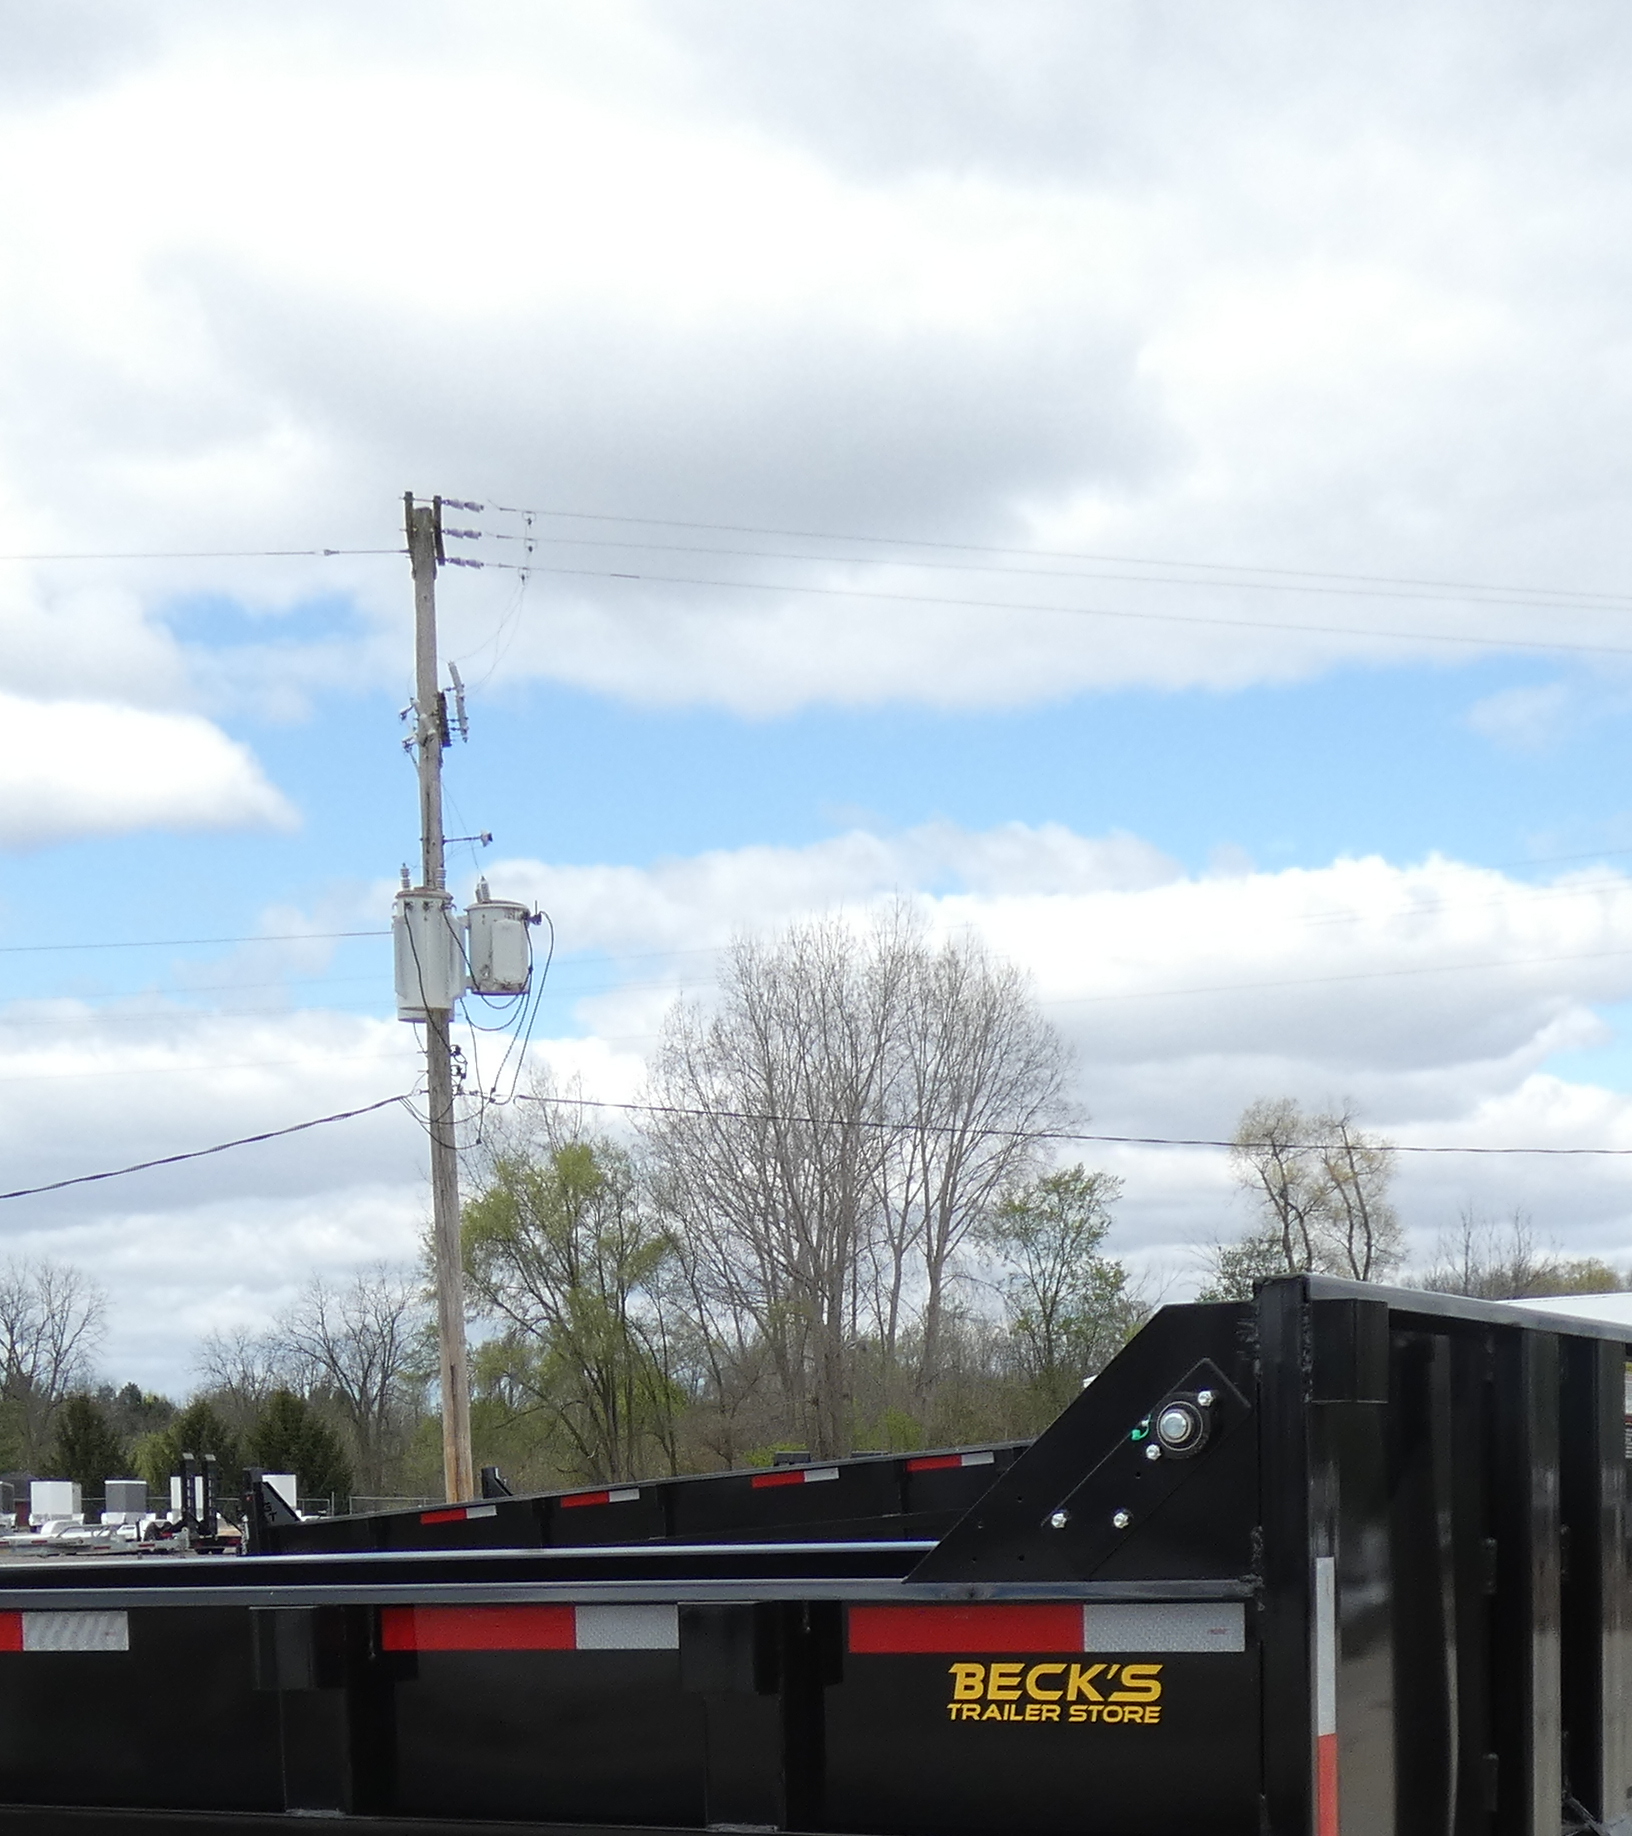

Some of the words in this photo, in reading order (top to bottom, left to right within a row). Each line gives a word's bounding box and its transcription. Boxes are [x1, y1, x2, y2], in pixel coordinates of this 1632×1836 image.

[948, 1663, 1164, 1702] BECK'S
[947, 1703, 1061, 1722] TRAILER
[1068, 1704, 1163, 1724] STORE
